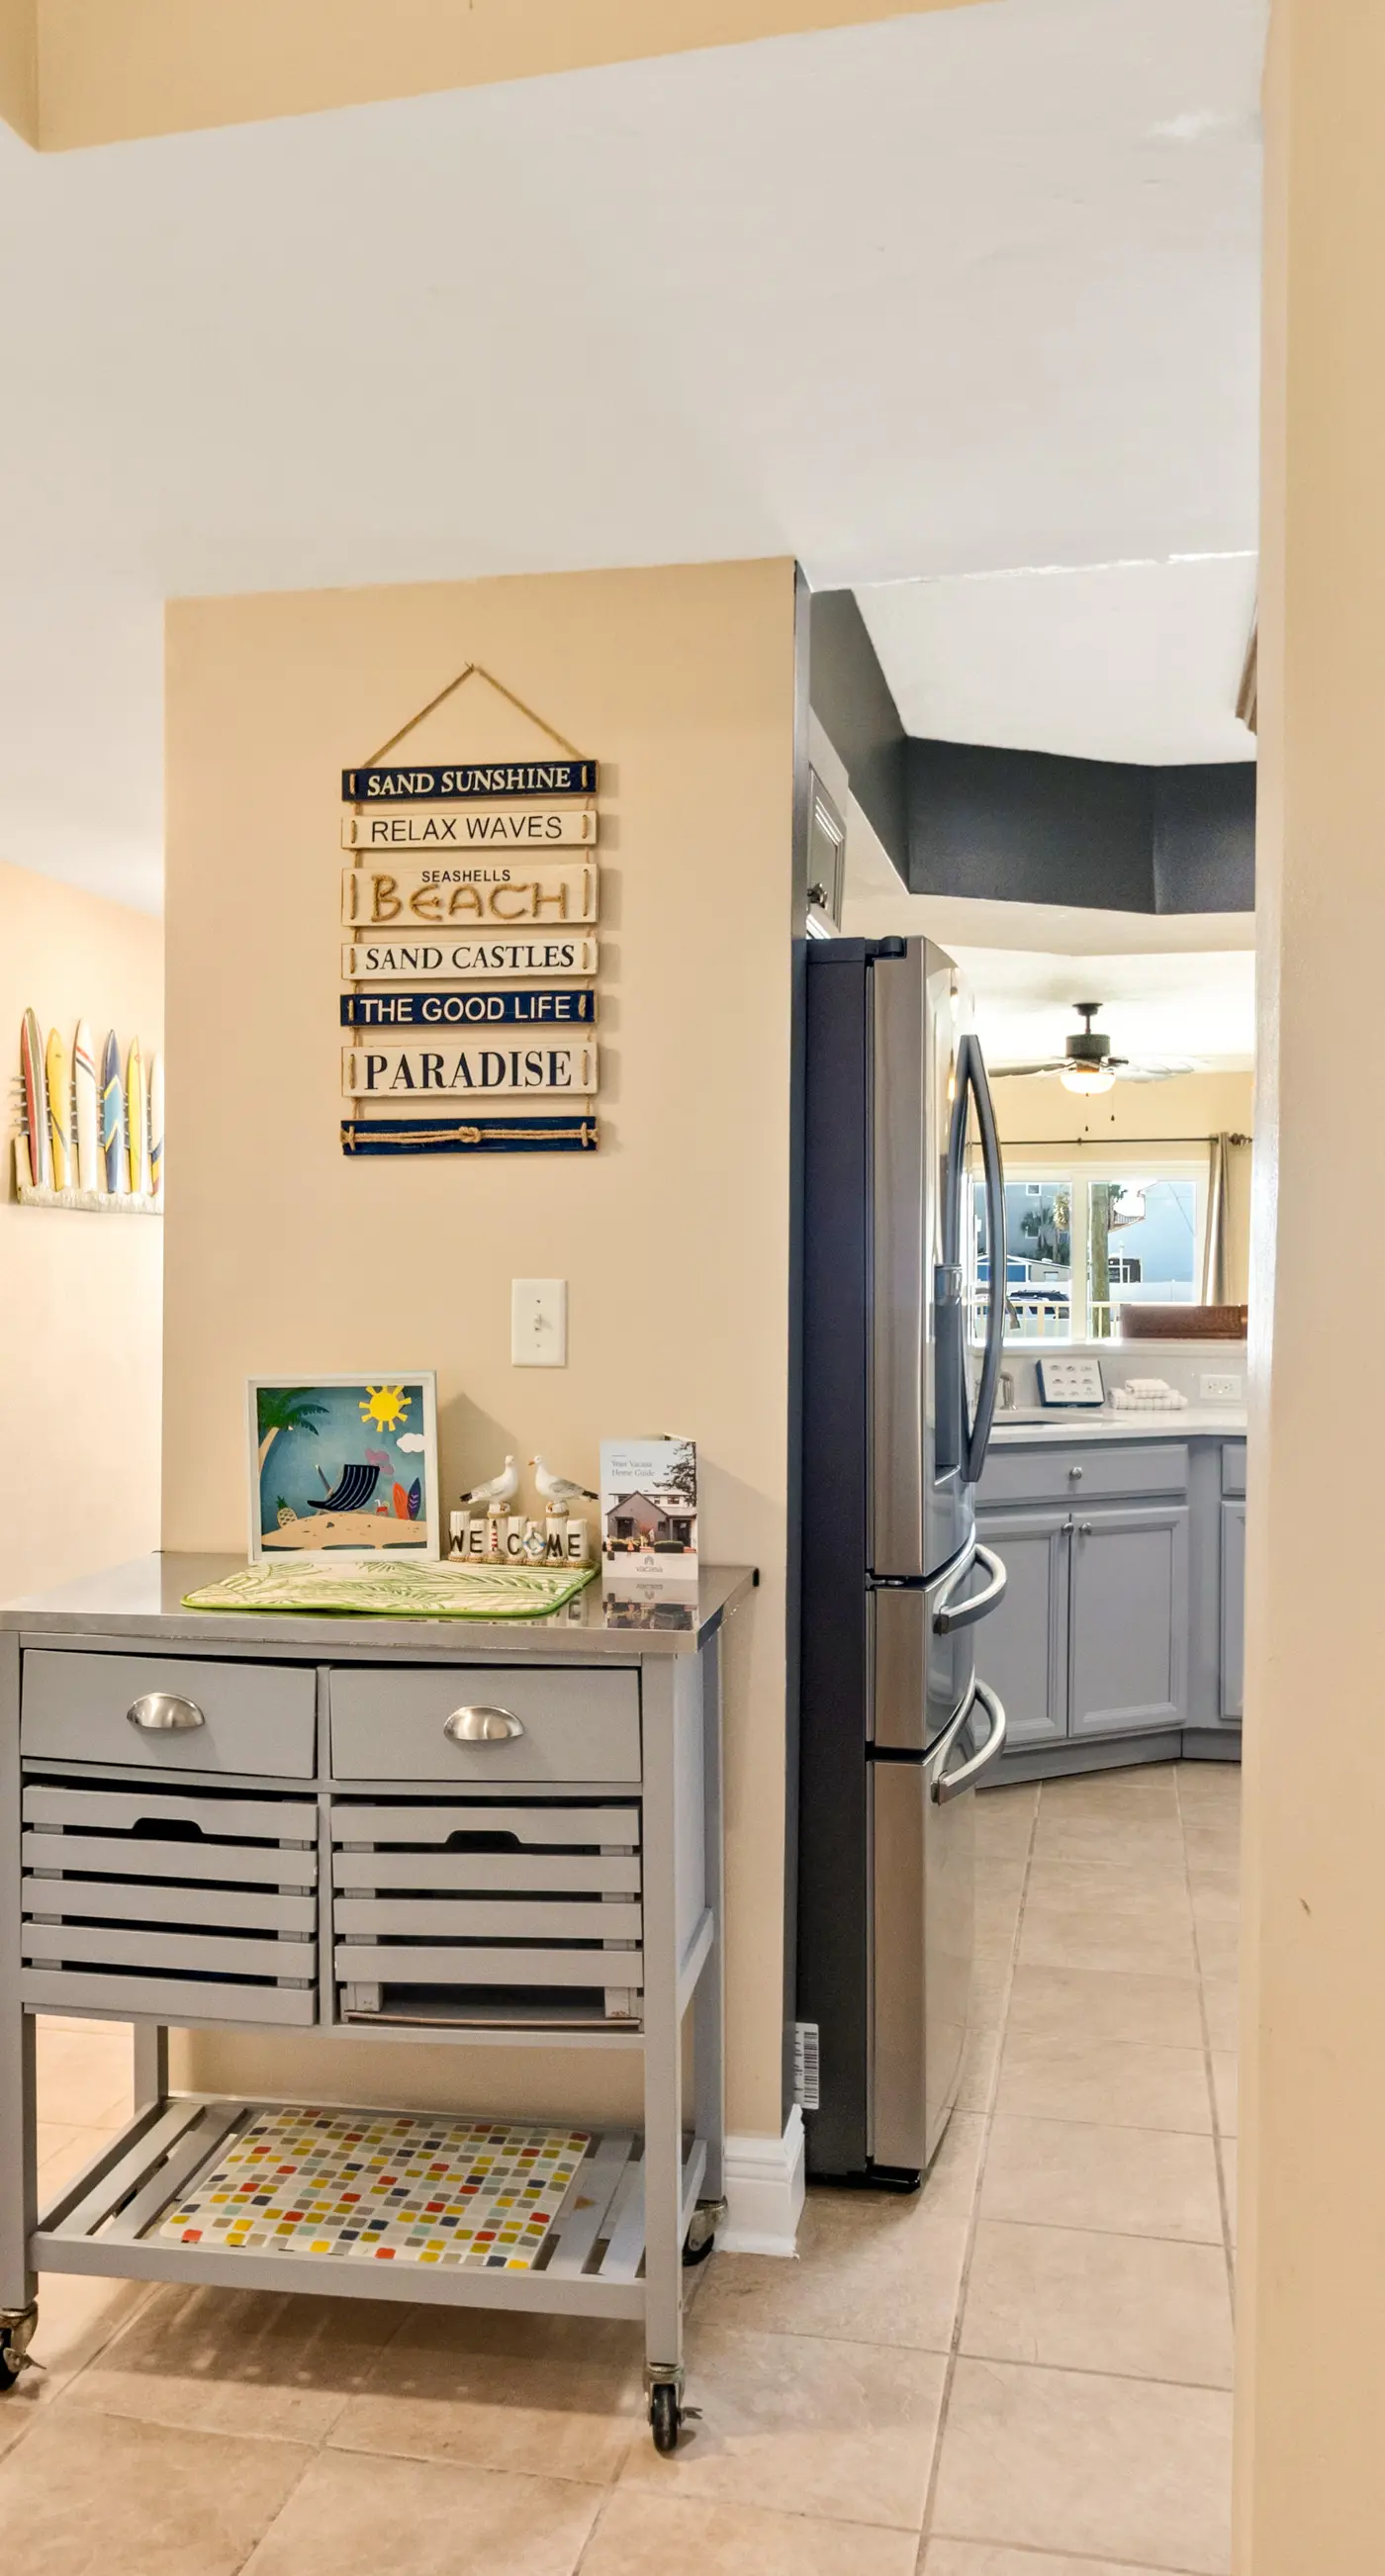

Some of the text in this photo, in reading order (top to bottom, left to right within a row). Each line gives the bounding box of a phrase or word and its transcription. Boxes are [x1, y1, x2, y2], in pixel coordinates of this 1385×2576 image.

[367, 767, 571, 796] SAND SUNSHINE
[371, 815, 563, 843] RELAX WAVES
[421, 869, 511, 883] SEASHELLS
[371, 874, 569, 922] BEACH
[365, 945, 575, 970] SAND CASTLES
[360, 994, 571, 1023] THE GOOD LIFE
[364, 1051, 572, 1091] PARADISE
